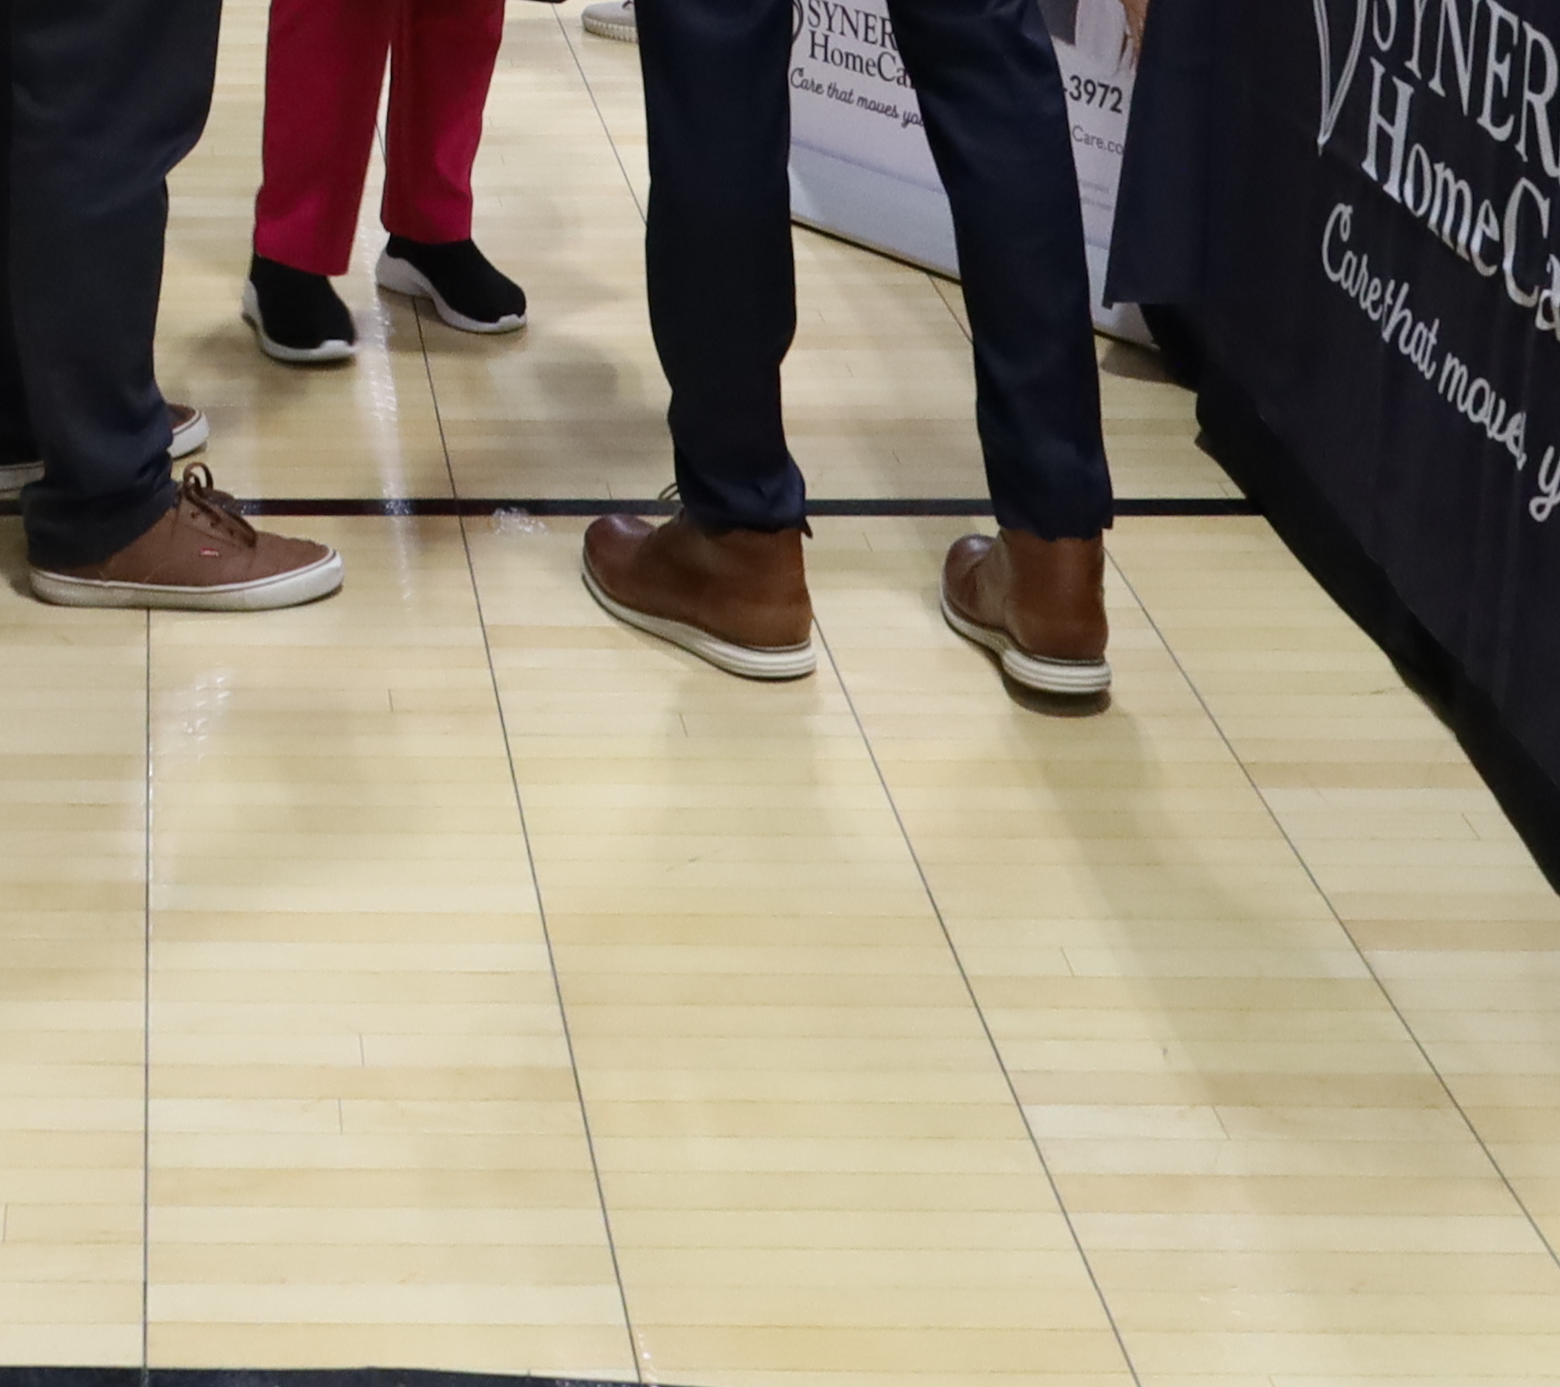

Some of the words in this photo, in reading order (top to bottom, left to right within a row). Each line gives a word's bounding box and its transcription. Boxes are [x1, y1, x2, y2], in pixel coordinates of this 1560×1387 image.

[790, 67, 824, 95] Care
[827, 82, 855, 105] that
[856, 95, 899, 119] moves
[1322, 203, 1383, 321] Care
[1382, 279, 1439, 380] that
